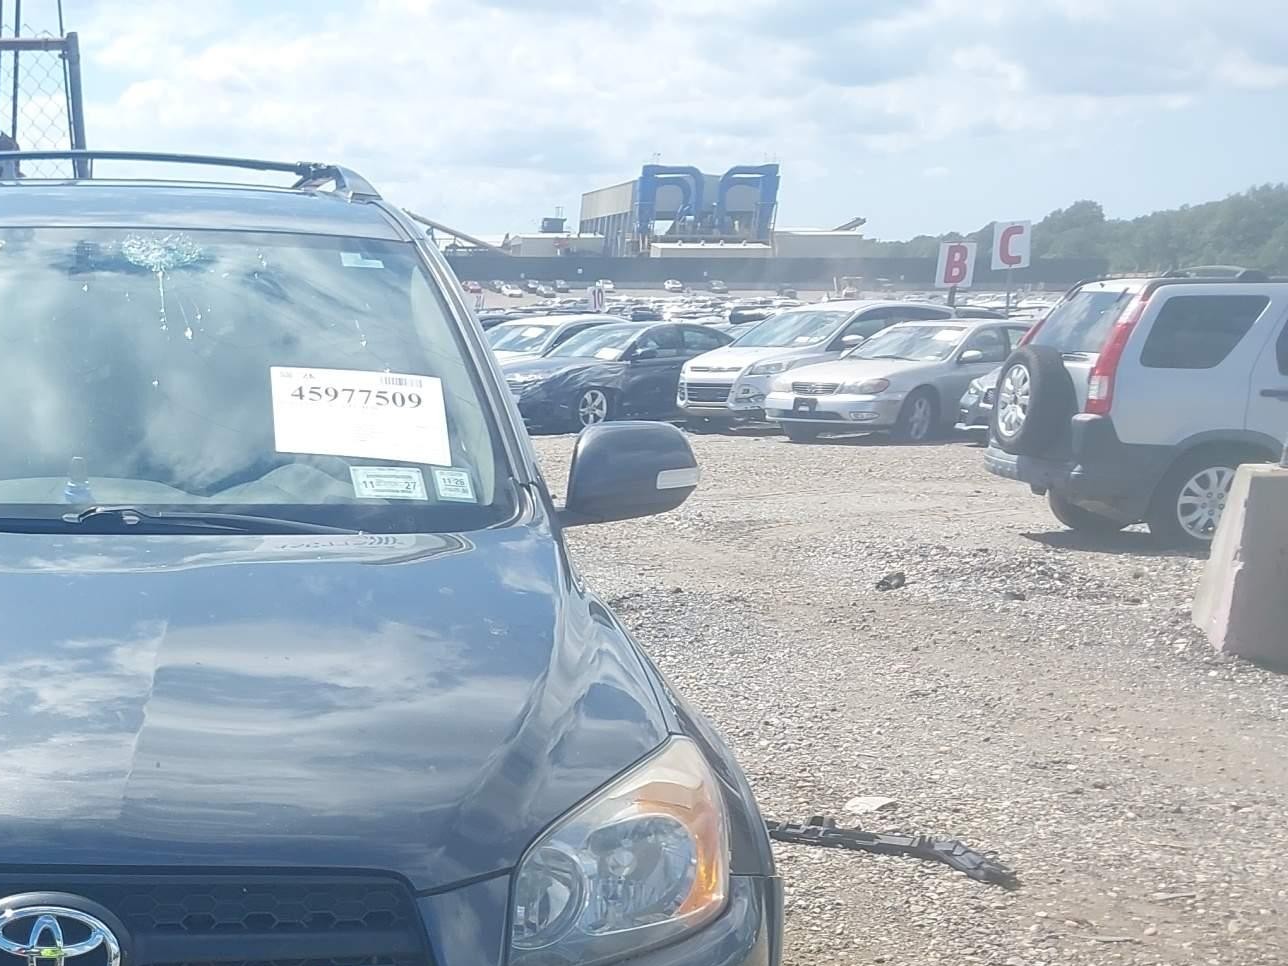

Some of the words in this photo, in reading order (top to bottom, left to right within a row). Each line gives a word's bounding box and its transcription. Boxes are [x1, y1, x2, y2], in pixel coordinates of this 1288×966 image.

[943, 244, 969, 284] B
[999, 225, 1024, 265] C
[290, 385, 422, 409] 45977509
